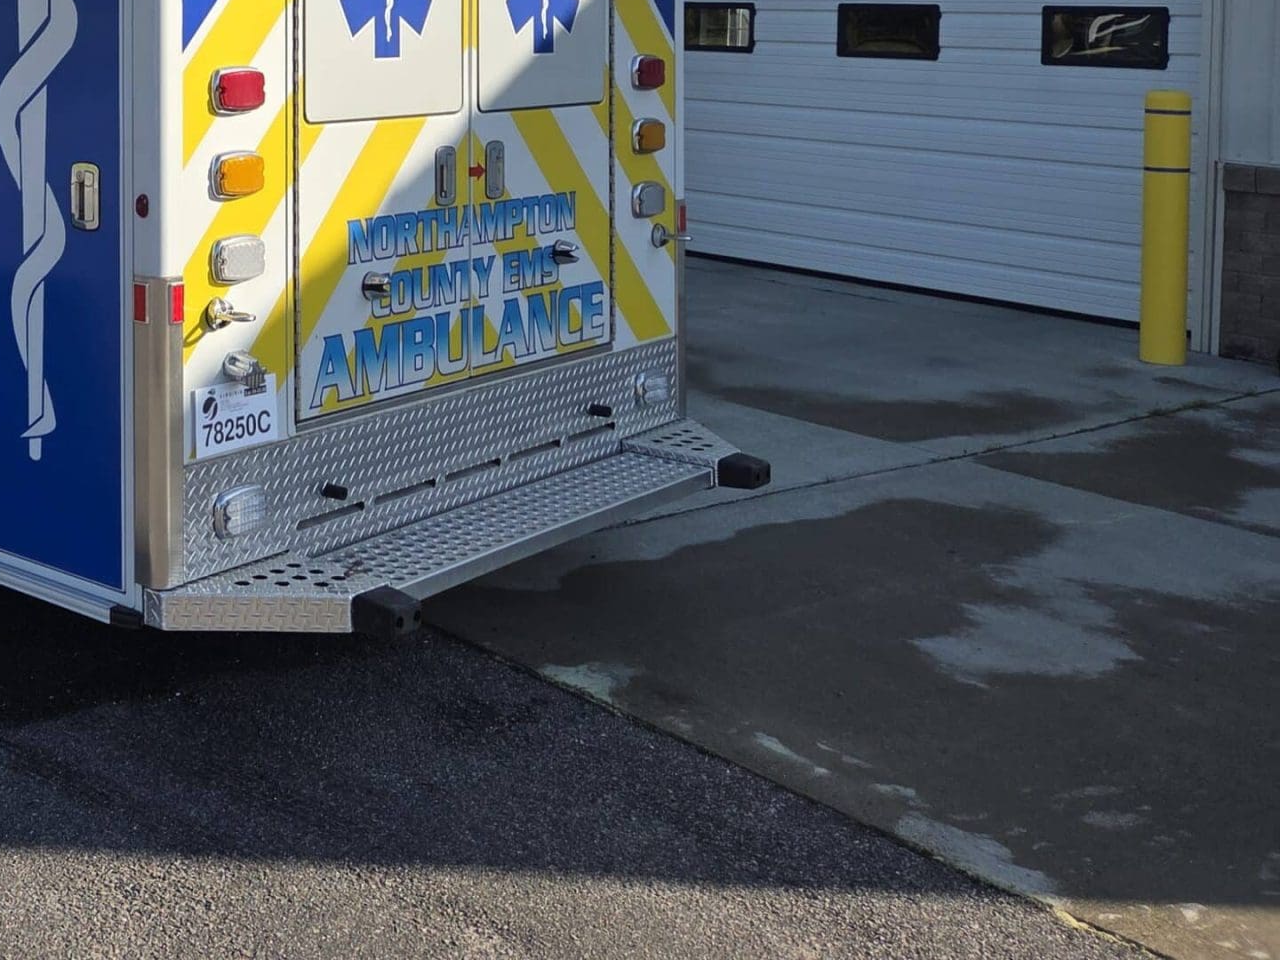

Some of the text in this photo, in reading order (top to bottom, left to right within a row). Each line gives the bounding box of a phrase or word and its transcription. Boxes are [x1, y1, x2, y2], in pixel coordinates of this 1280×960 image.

[347, 191, 577, 265] NORTHAMPTON
[502, 244, 560, 294] EMS
[309, 280, 605, 410] AMBULANCE
[202, 410, 272, 448] 78250C
